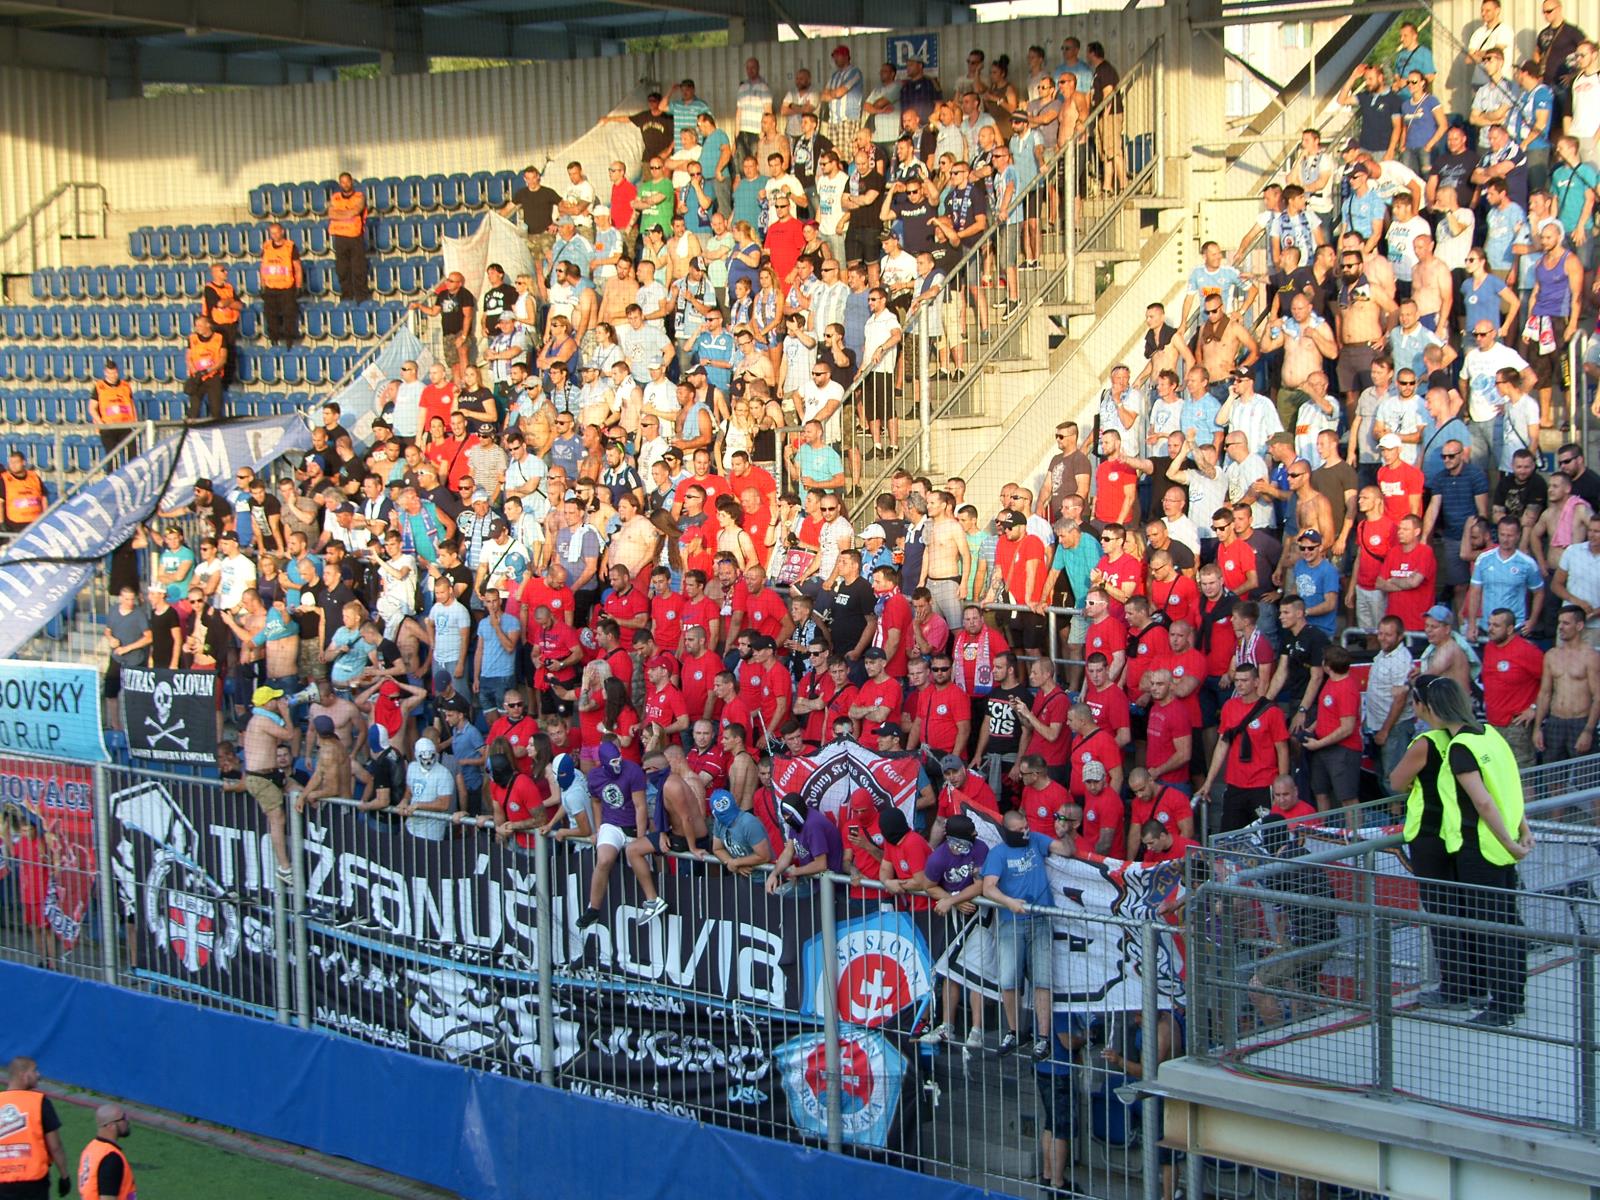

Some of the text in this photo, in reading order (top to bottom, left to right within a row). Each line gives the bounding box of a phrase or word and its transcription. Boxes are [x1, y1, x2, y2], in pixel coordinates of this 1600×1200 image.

[894, 38, 930, 66] D4
[0, 675, 84, 714] OVSKÝ
[173, 673, 215, 697] SLOVAN
[728, 1083, 769, 1105] USP
